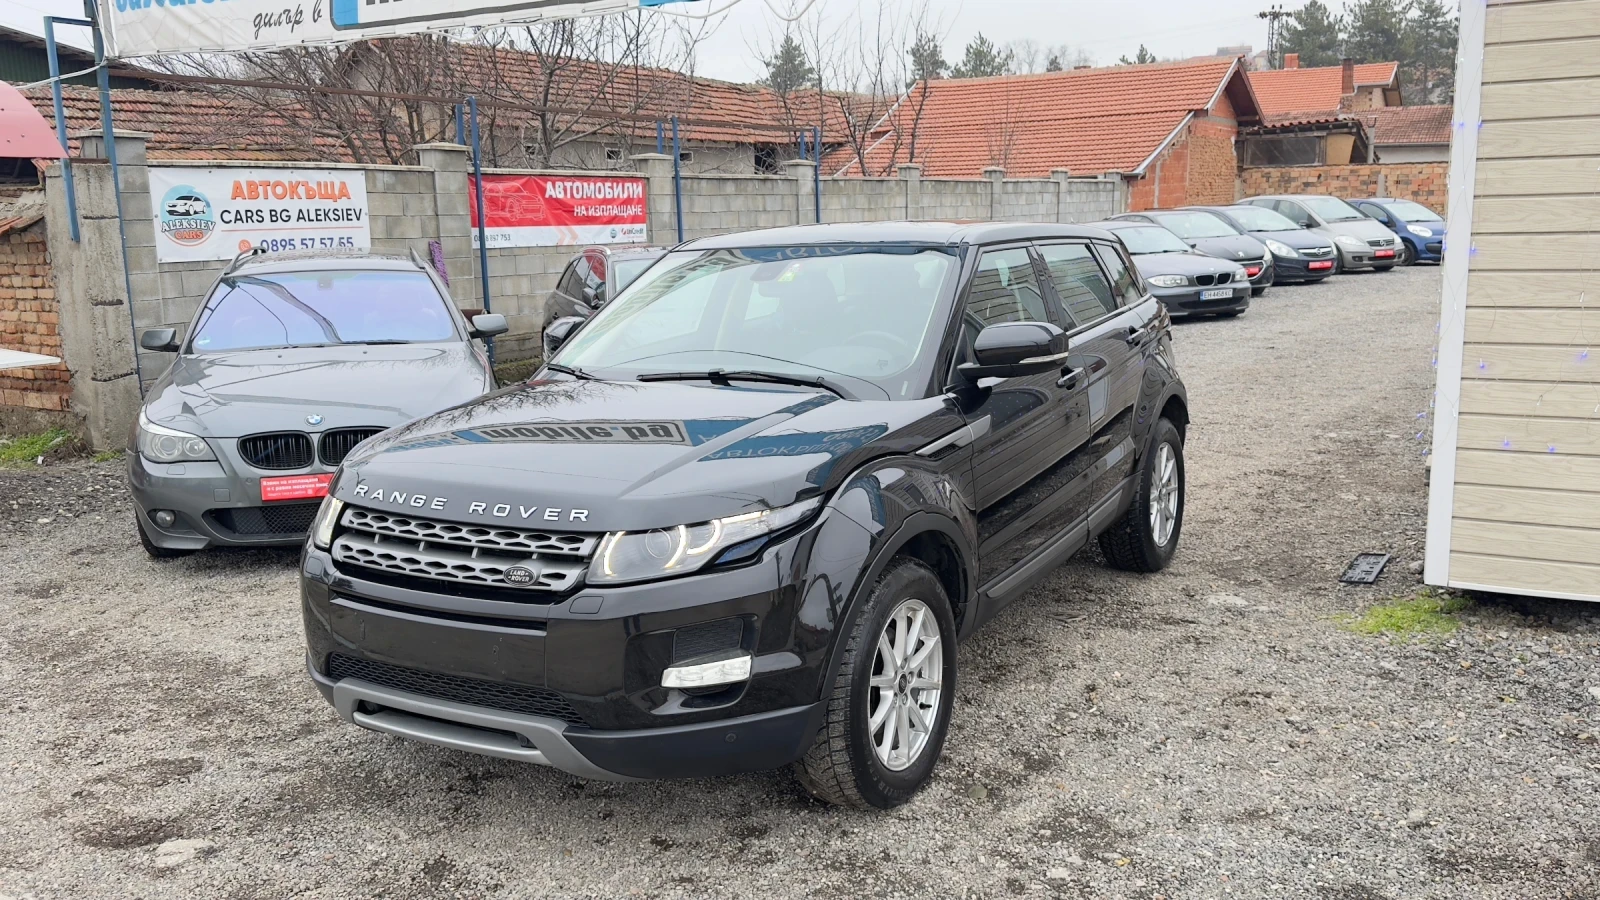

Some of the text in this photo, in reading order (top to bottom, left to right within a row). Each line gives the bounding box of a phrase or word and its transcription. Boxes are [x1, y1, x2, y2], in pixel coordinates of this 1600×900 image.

[230, 180, 352, 202] АВТОКЪЩА
[545, 181, 643, 199] АВТОМОБИЛИ
[220, 207, 363, 224] CARS BG ALEKSIEV
[574, 204, 643, 219] НА ИЗПЛАЩАНЕ
[161, 217, 216, 233] ALEKSIEV
[174, 229, 204, 240] CARS
[260, 238, 296, 252] 0895
[353, 484, 591, 523] RANGE ROVER
